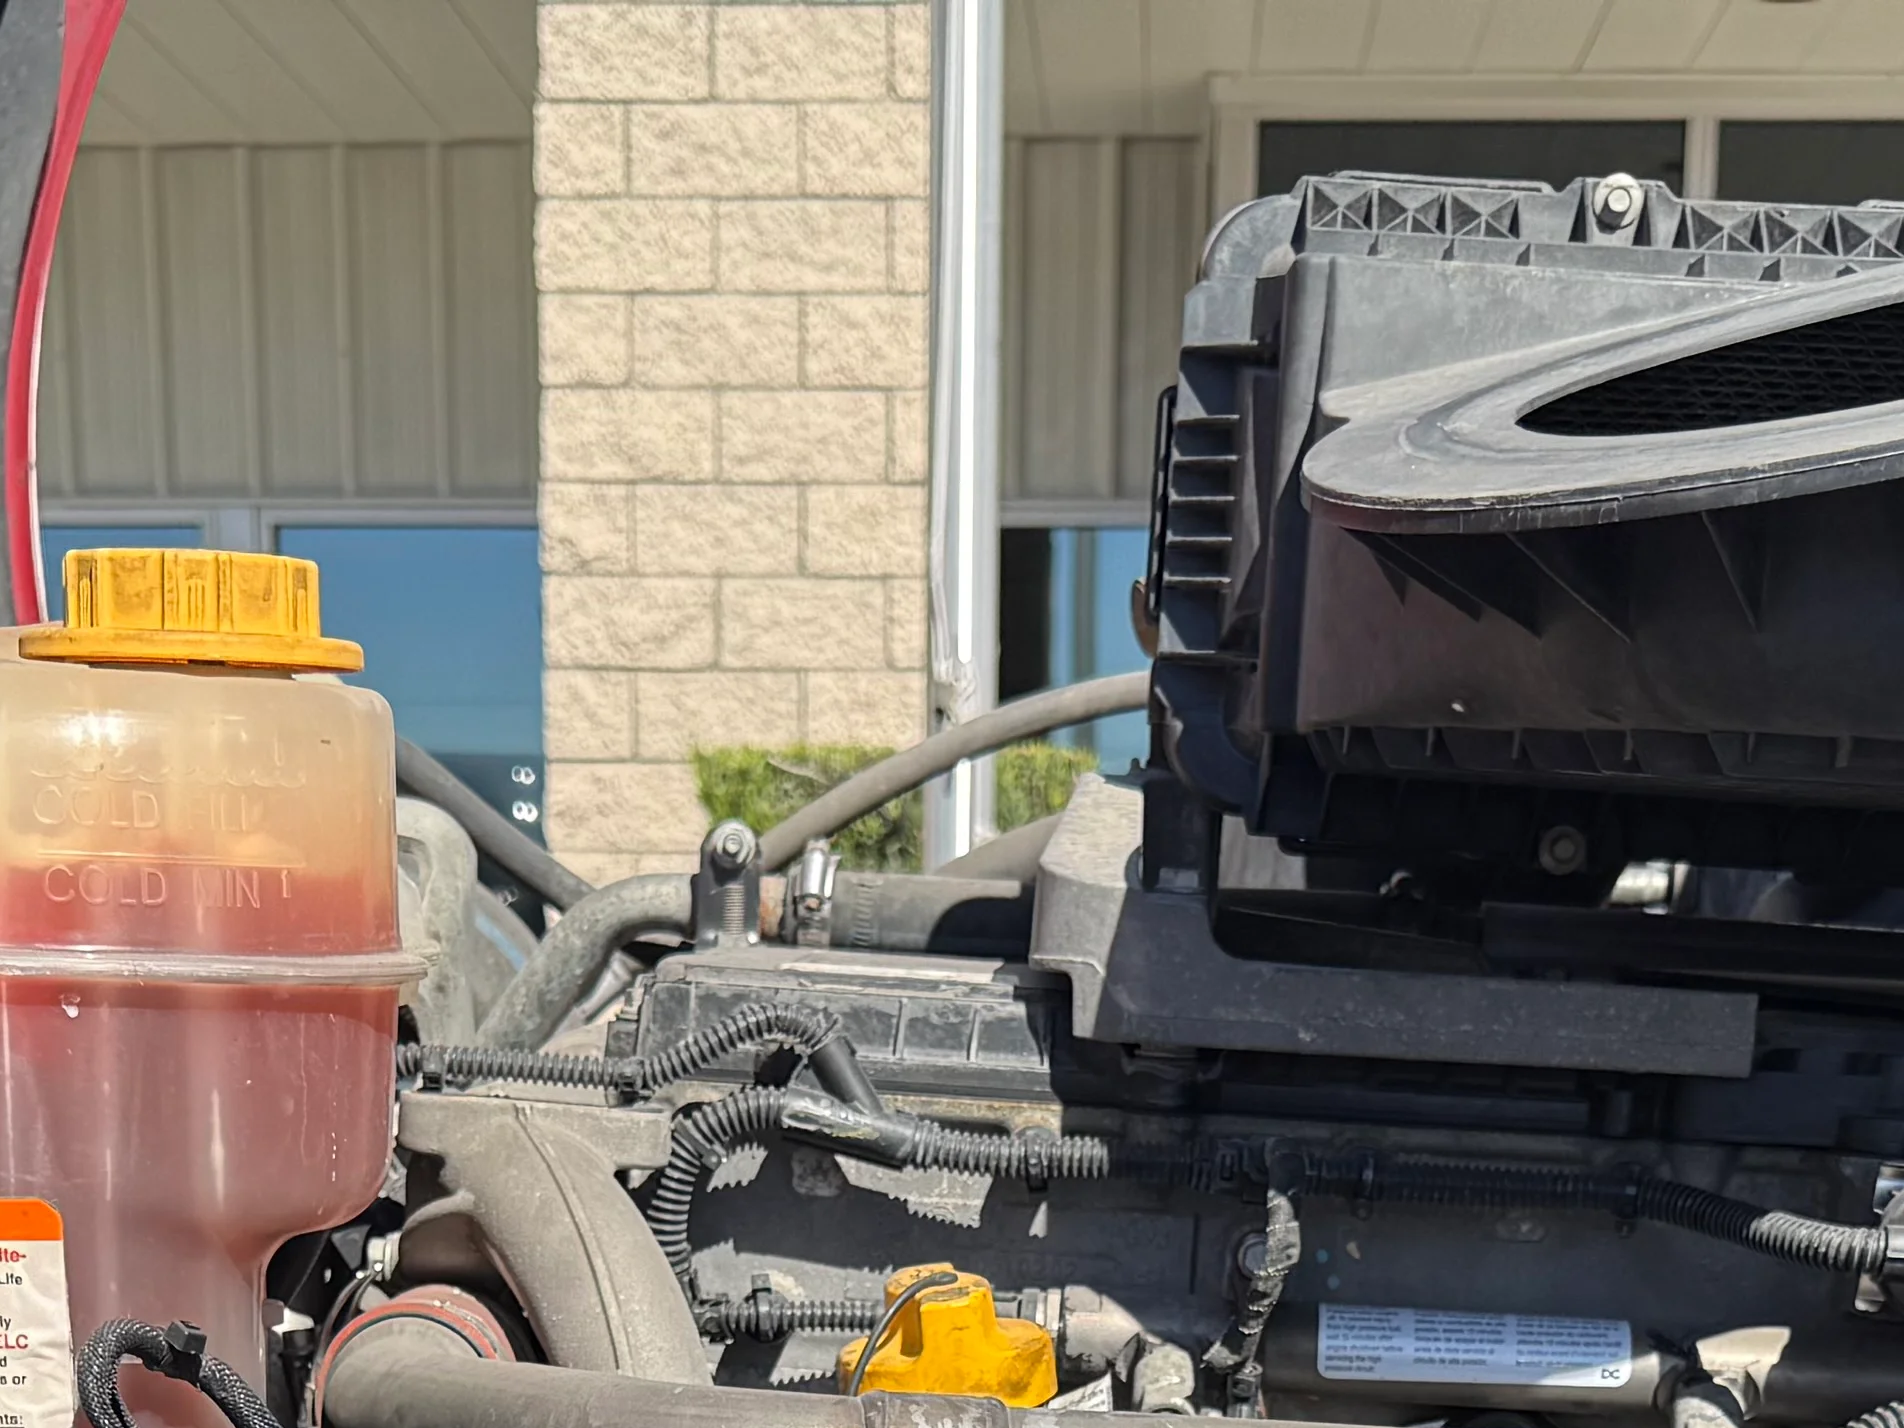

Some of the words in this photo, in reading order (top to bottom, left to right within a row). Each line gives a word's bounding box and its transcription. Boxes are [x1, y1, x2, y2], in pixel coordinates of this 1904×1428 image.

[32, 784, 160, 830] COLD
[42, 863, 168, 906] COLD
[193, 867, 261, 909] MIN
[12, 1374, 27, 1385] or
